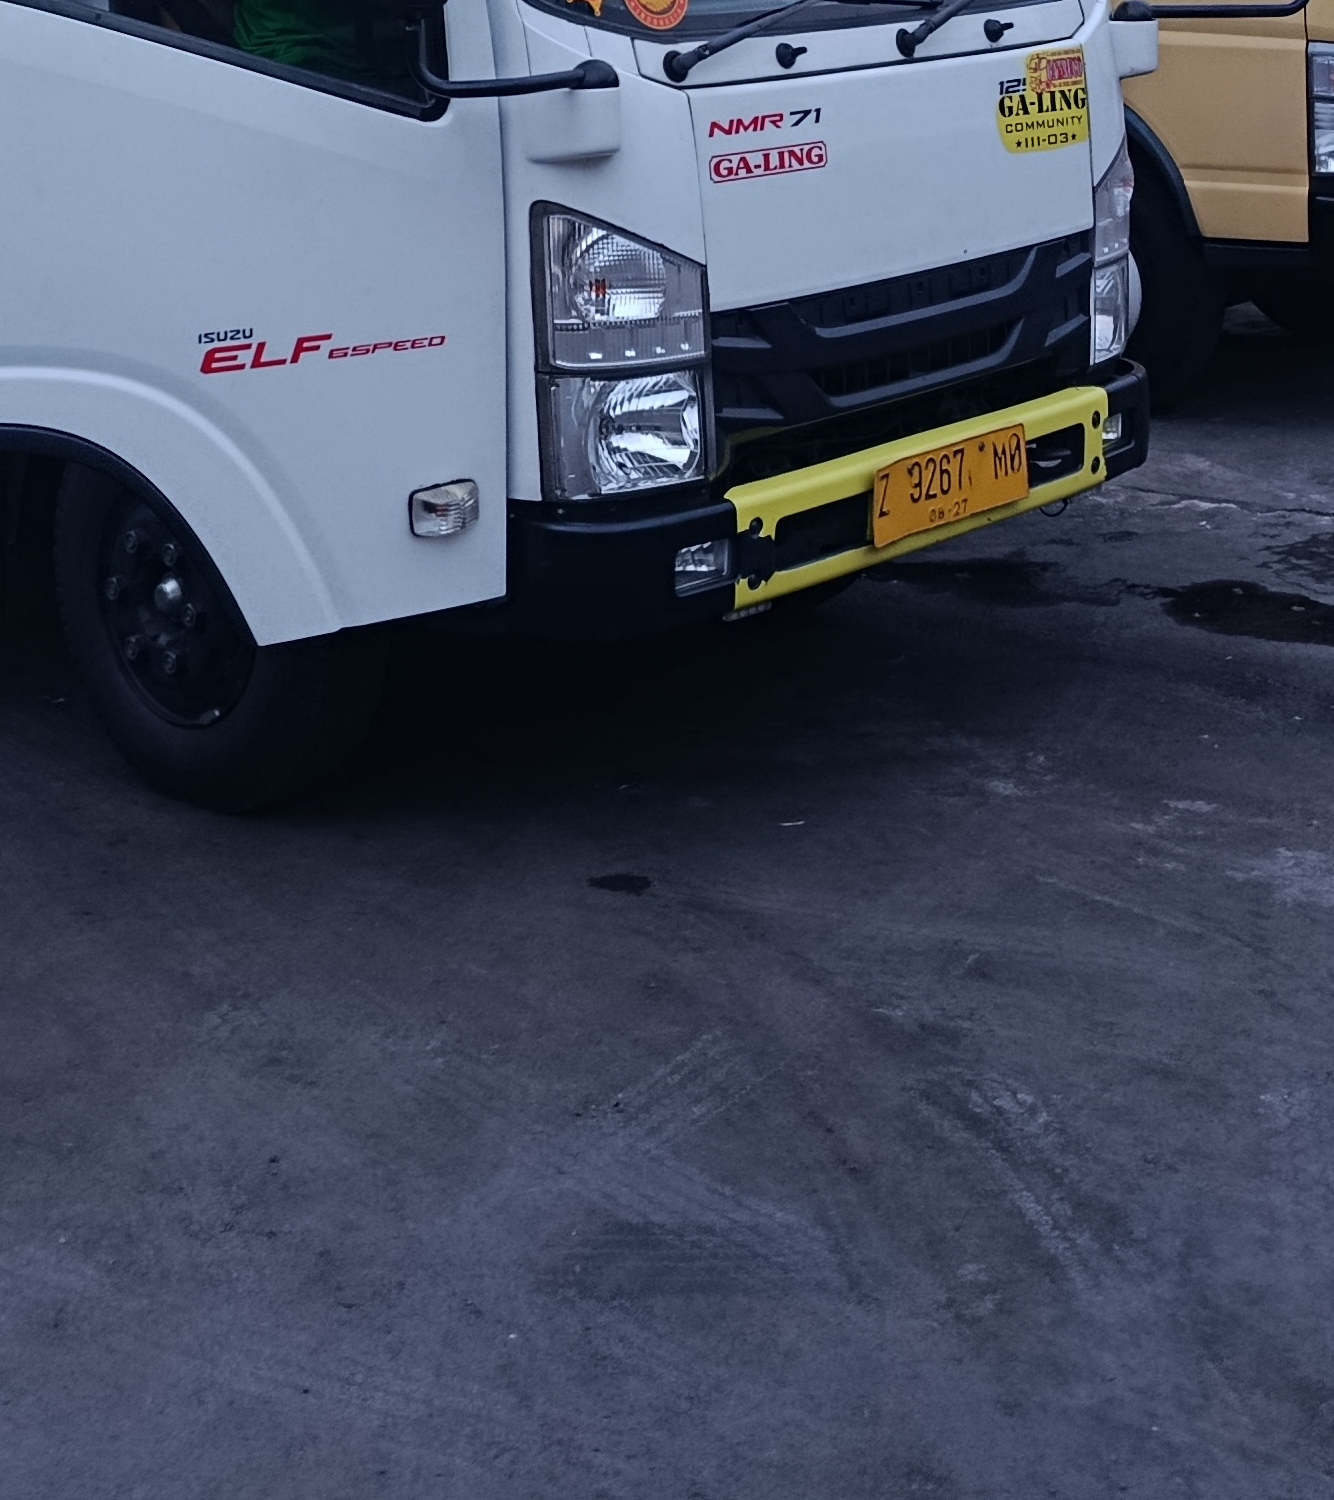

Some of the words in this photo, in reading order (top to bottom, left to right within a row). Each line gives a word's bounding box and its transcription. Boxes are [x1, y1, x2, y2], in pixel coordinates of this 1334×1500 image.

[999, 88, 1088, 118] GA-LING
[708, 113, 784, 138] NMR
[789, 107, 822, 127] 71
[1005, 115, 1083, 134] COMMUNITY
[713, 145, 824, 178] GA-LING
[198, 327, 254, 344] ISUZU
[200, 333, 333, 375] ELF
[878, 472, 890, 519] Z
[907, 447, 965, 503] 9267
